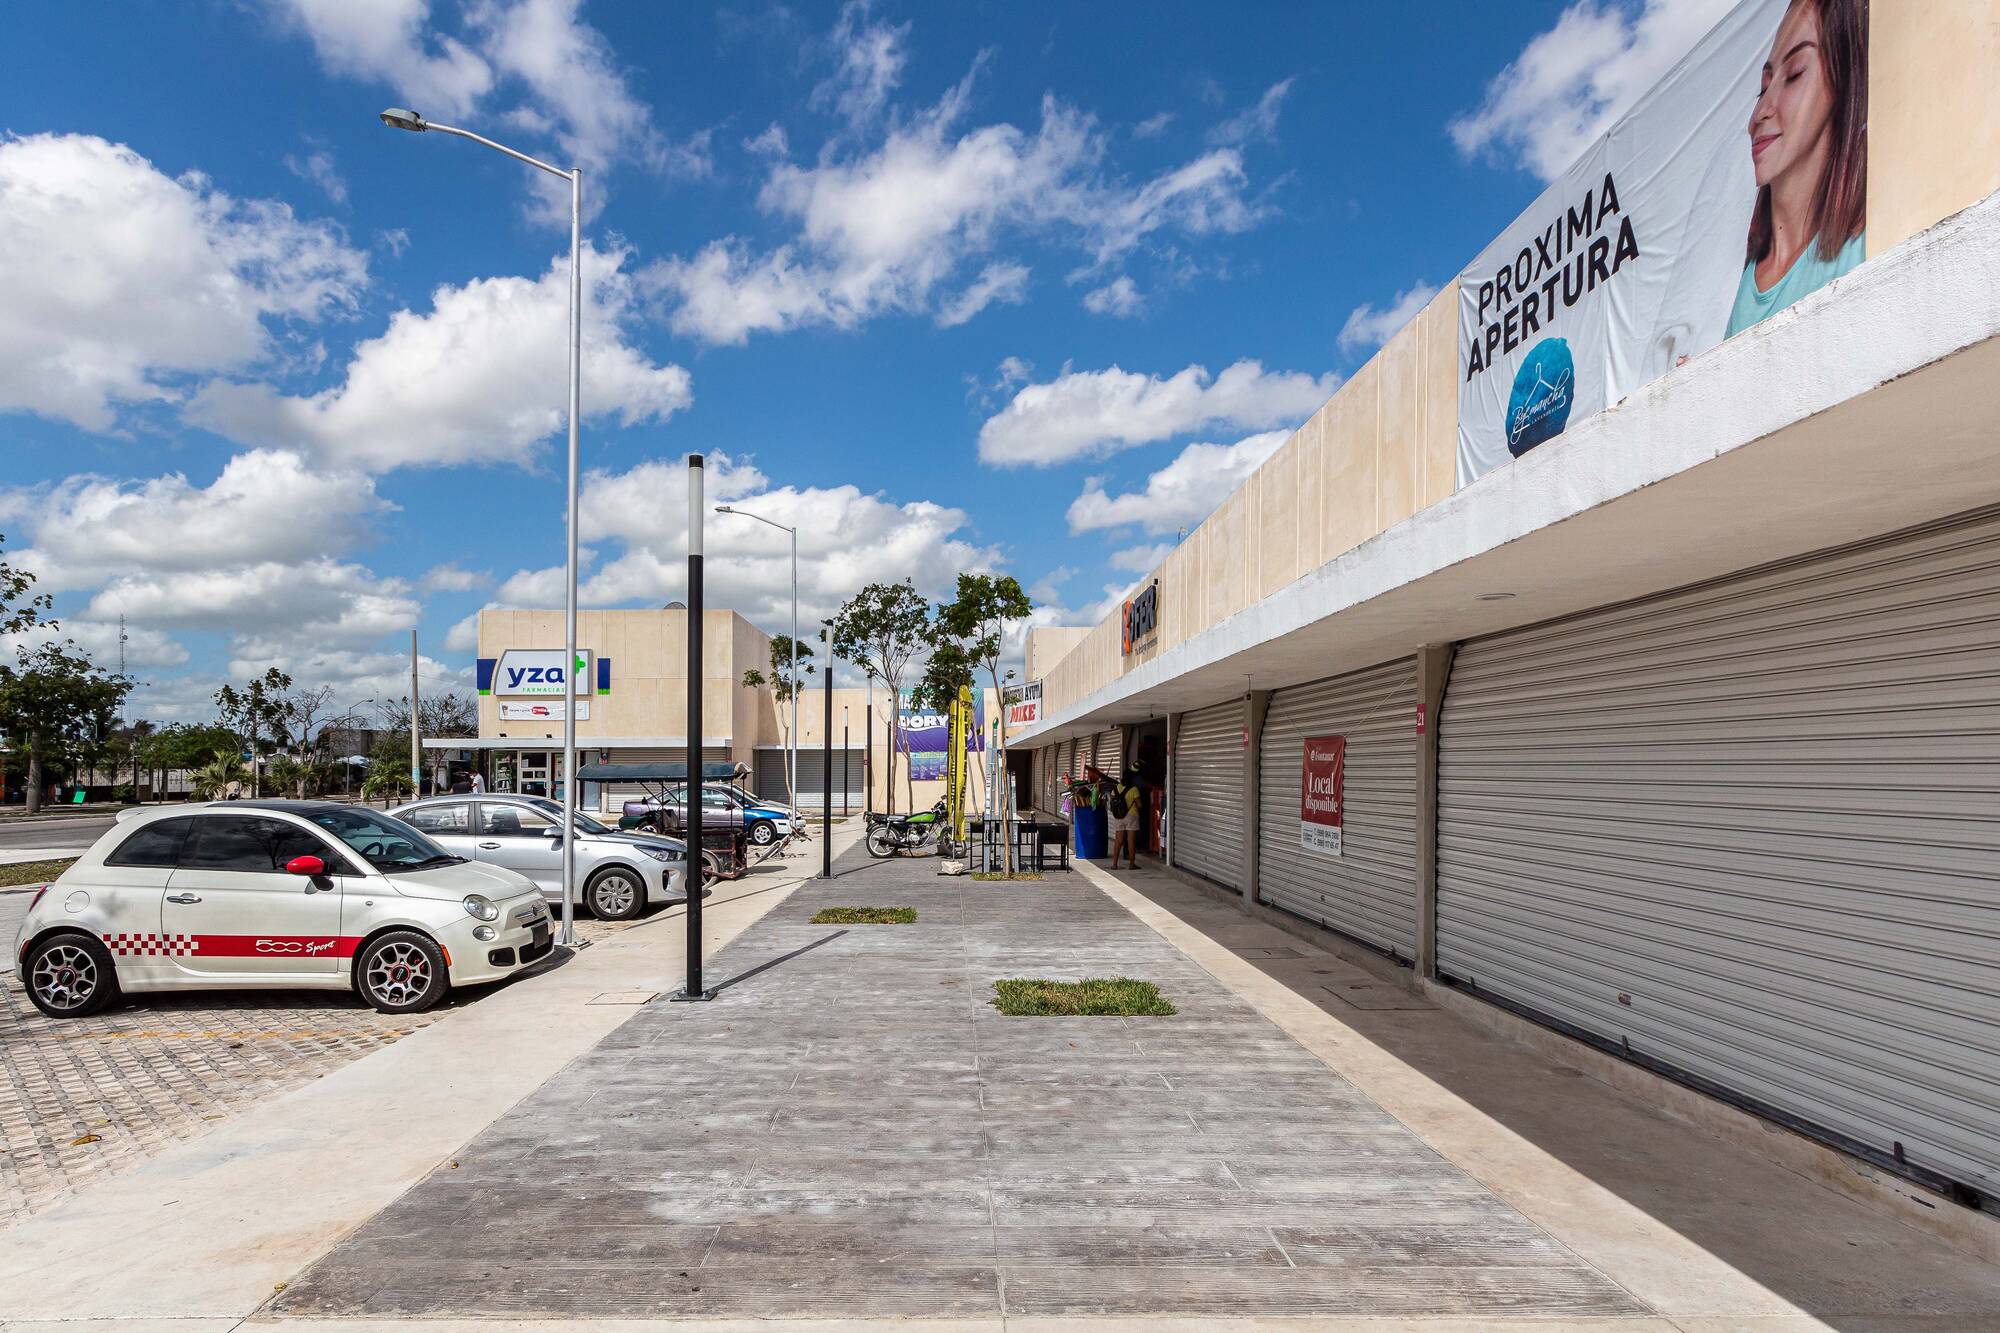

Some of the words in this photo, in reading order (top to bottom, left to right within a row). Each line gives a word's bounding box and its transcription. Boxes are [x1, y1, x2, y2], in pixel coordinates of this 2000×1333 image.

[1479, 172, 1620, 326] PROXIMA
[1466, 215, 1640, 383] APERTURA
[507, 667, 565, 688] yza
[897, 715, 949, 729] DORY
[1011, 704, 1036, 723] MIKE
[1417, 712, 1424, 726] 21
[1310, 772, 1334, 794] Local
[1305, 795, 1338, 814] disponible
[256, 940, 302, 952] 500
[306, 941, 336, 956] Sport
